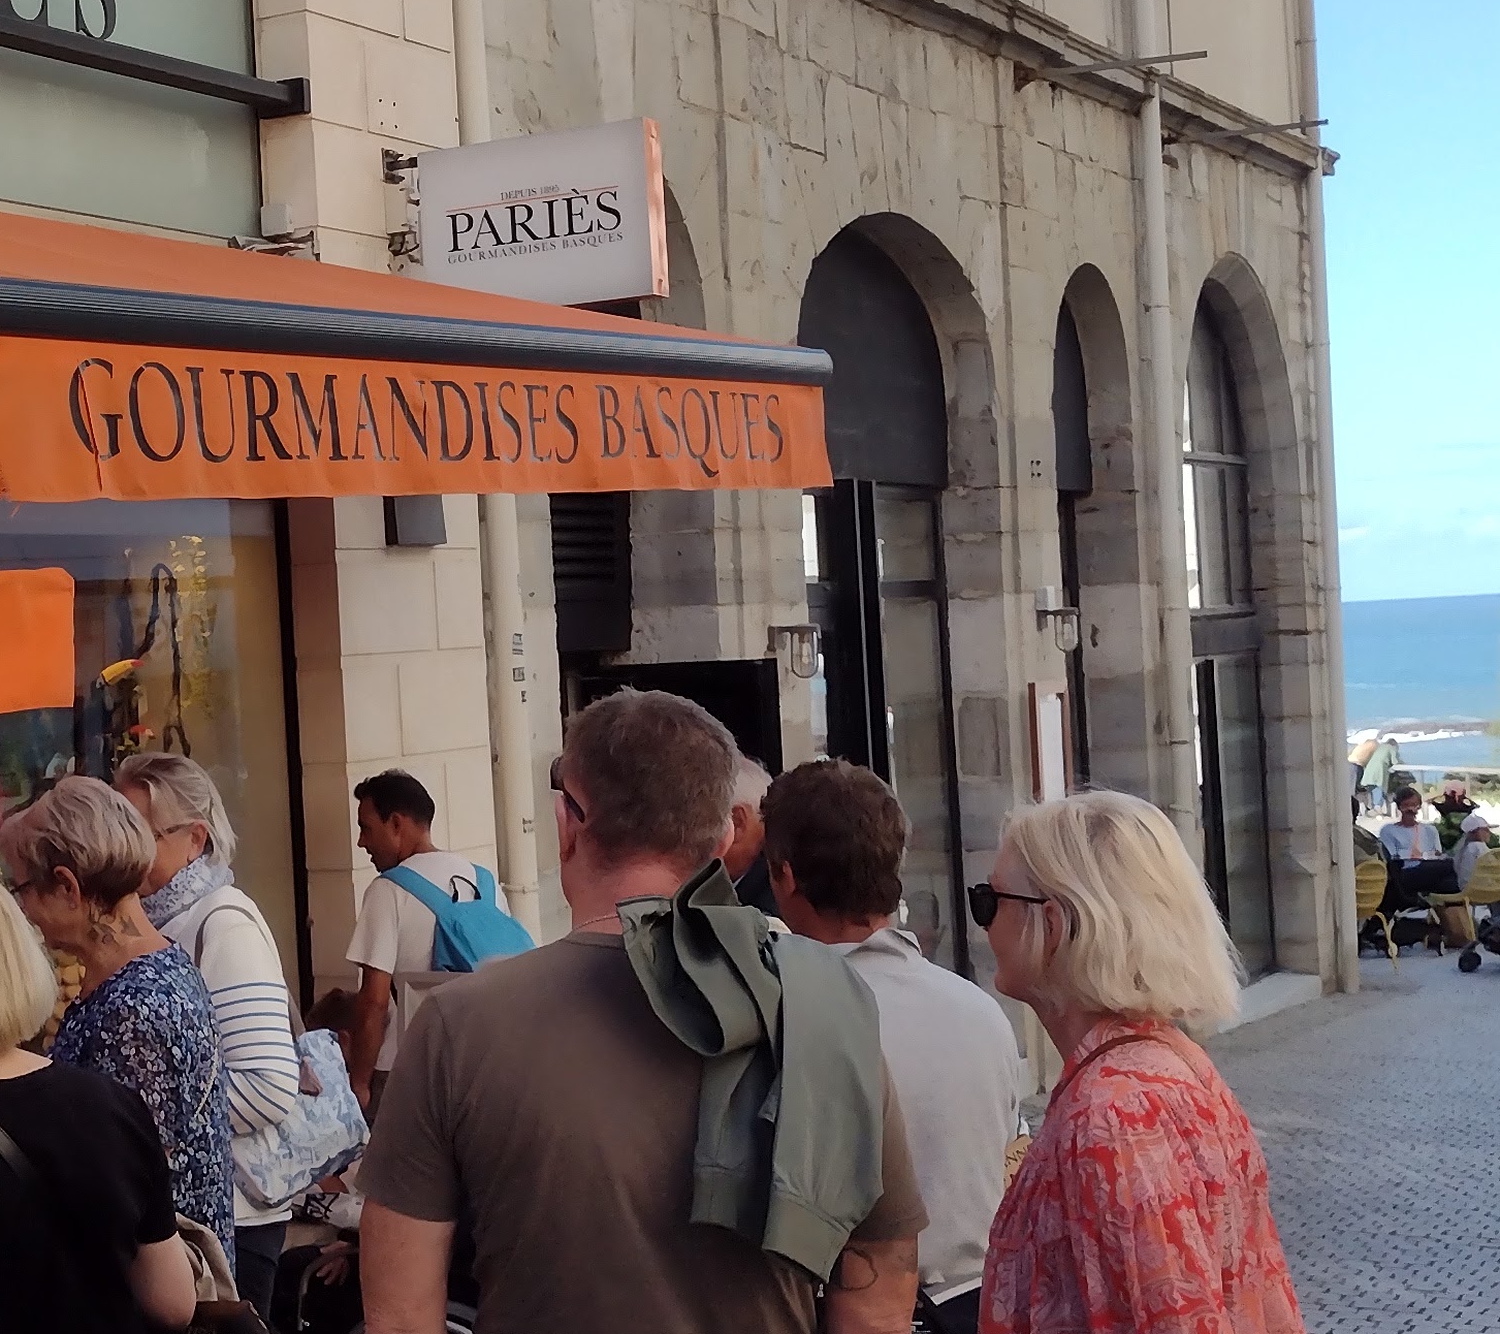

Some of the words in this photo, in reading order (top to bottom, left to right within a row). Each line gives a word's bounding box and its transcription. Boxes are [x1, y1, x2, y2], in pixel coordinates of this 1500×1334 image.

[500, 187, 538, 201] DEPUIS
[445, 188, 622, 253] PARIÈS
[447, 240, 557, 265] GOURMANDISES
[562, 231, 624, 250] BASQUES
[68, 357, 579, 465] GOURMANDISES
[594, 383, 785, 479] BASQUES
